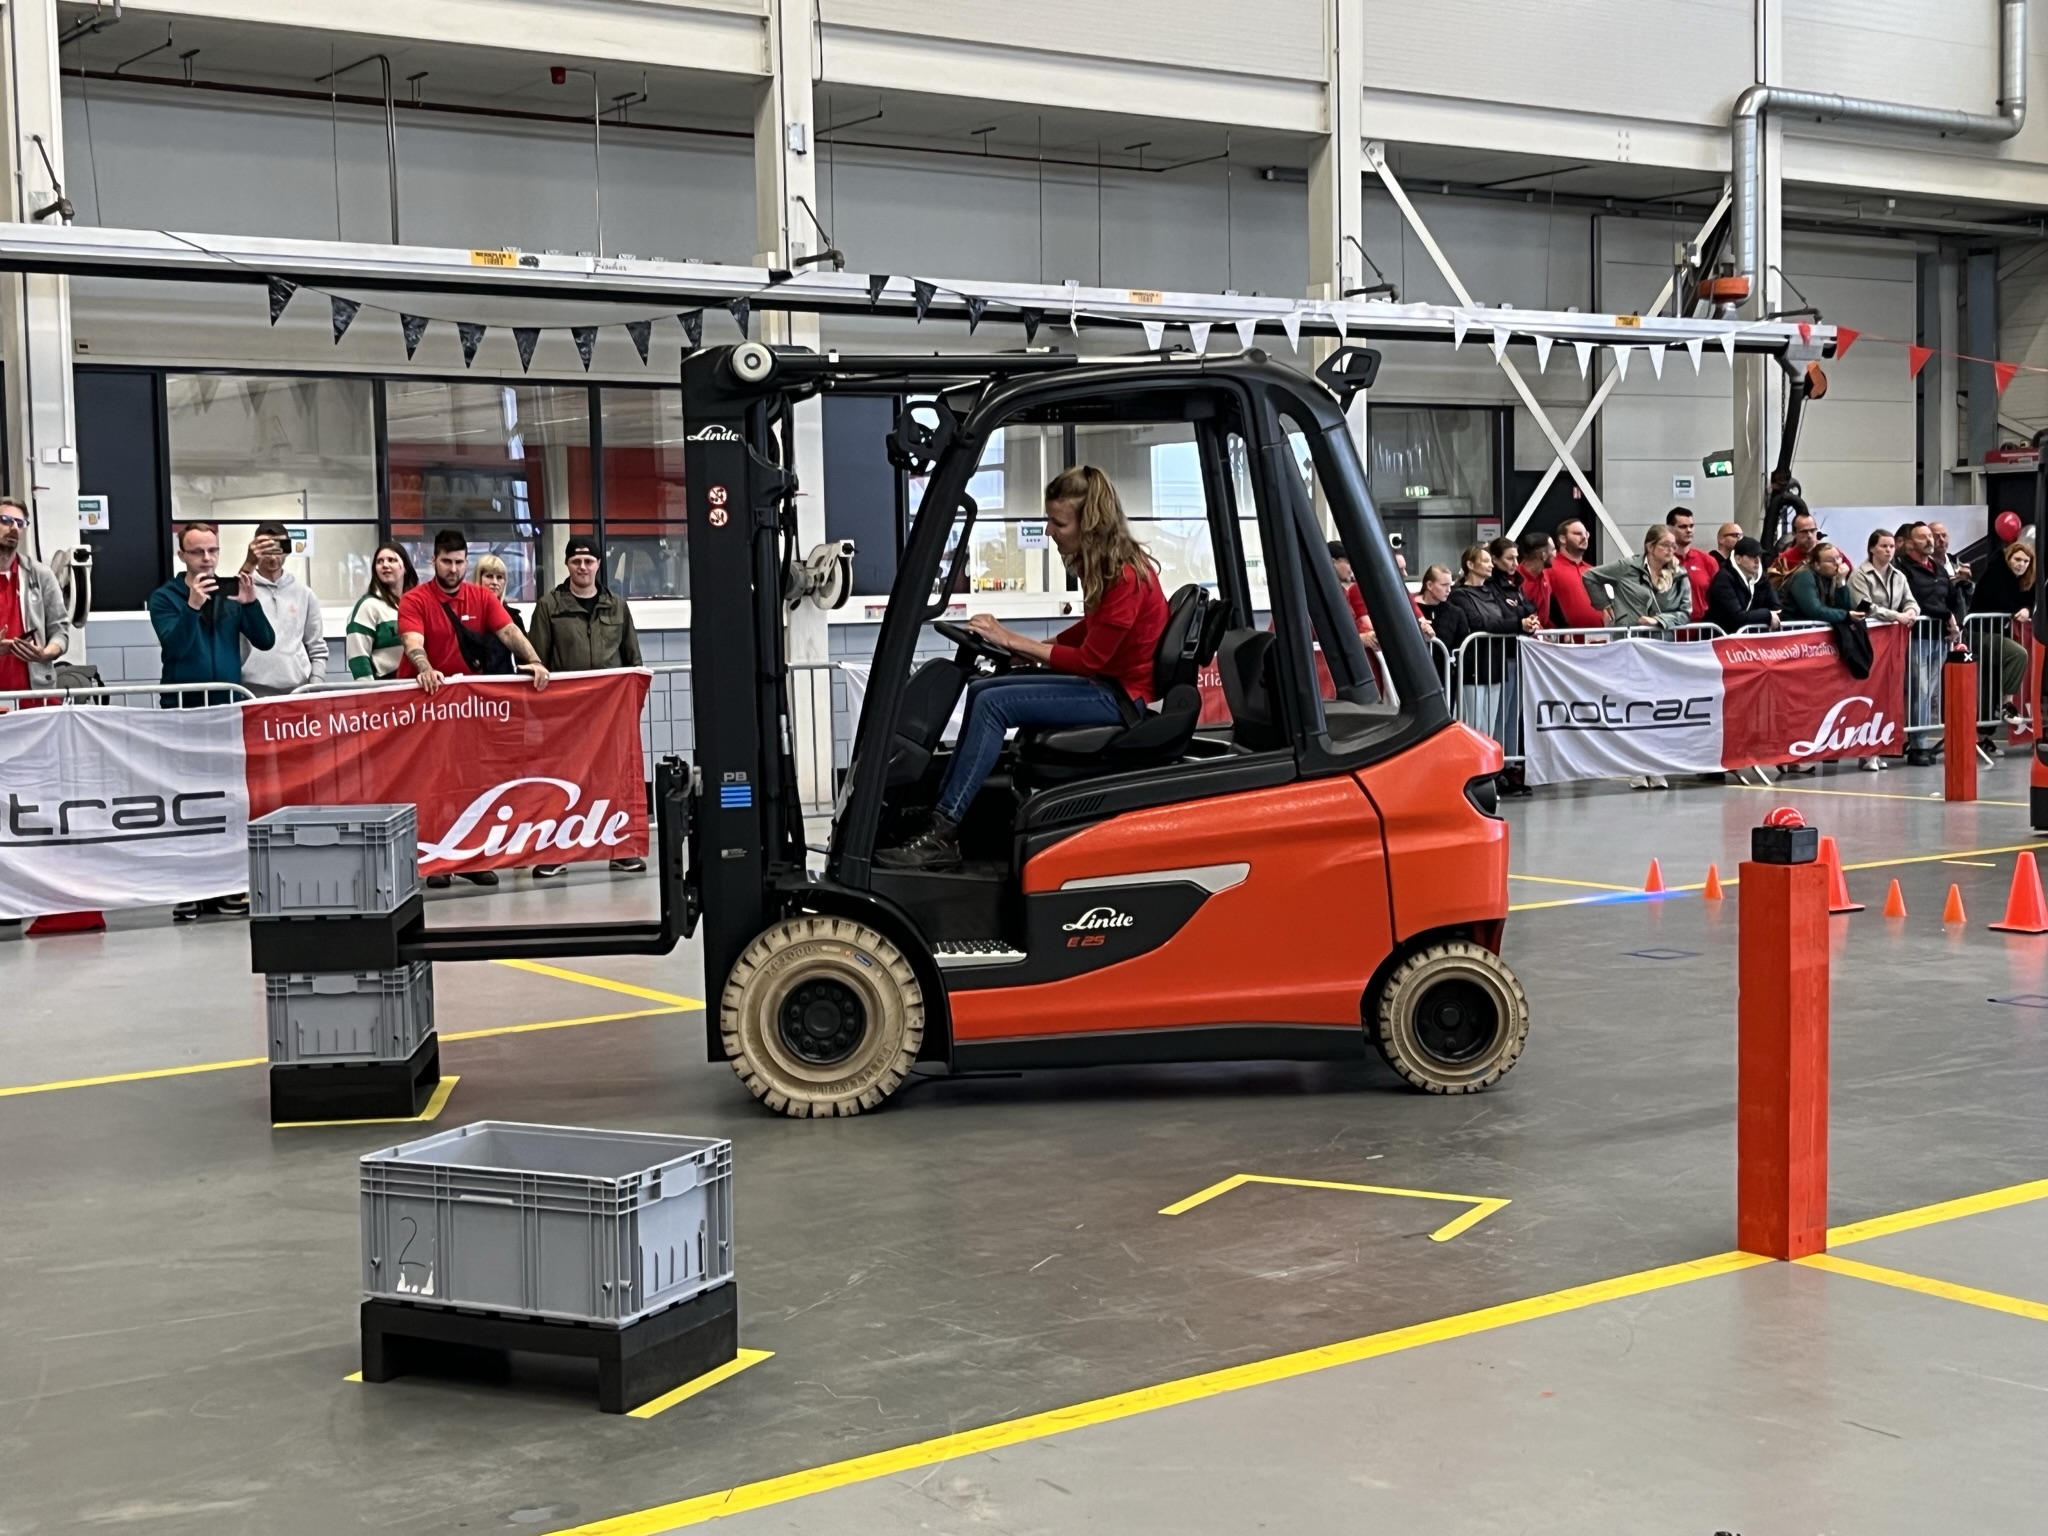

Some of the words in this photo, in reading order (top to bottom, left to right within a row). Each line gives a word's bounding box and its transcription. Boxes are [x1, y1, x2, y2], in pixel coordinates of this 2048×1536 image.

[686, 424, 740, 441] Linde
[263, 714, 322, 742] Linde
[329, 703, 416, 735] Material
[422, 695, 511, 722] Handling
[1537, 695, 1713, 724] motrac
[1788, 695, 1896, 757] Linde
[0, 791, 227, 837] trac
[417, 776, 631, 865] Linde
[1062, 906, 1134, 931] Linde
[1080, 934, 1106, 947] 25
[398, 1216, 427, 1268] 2
